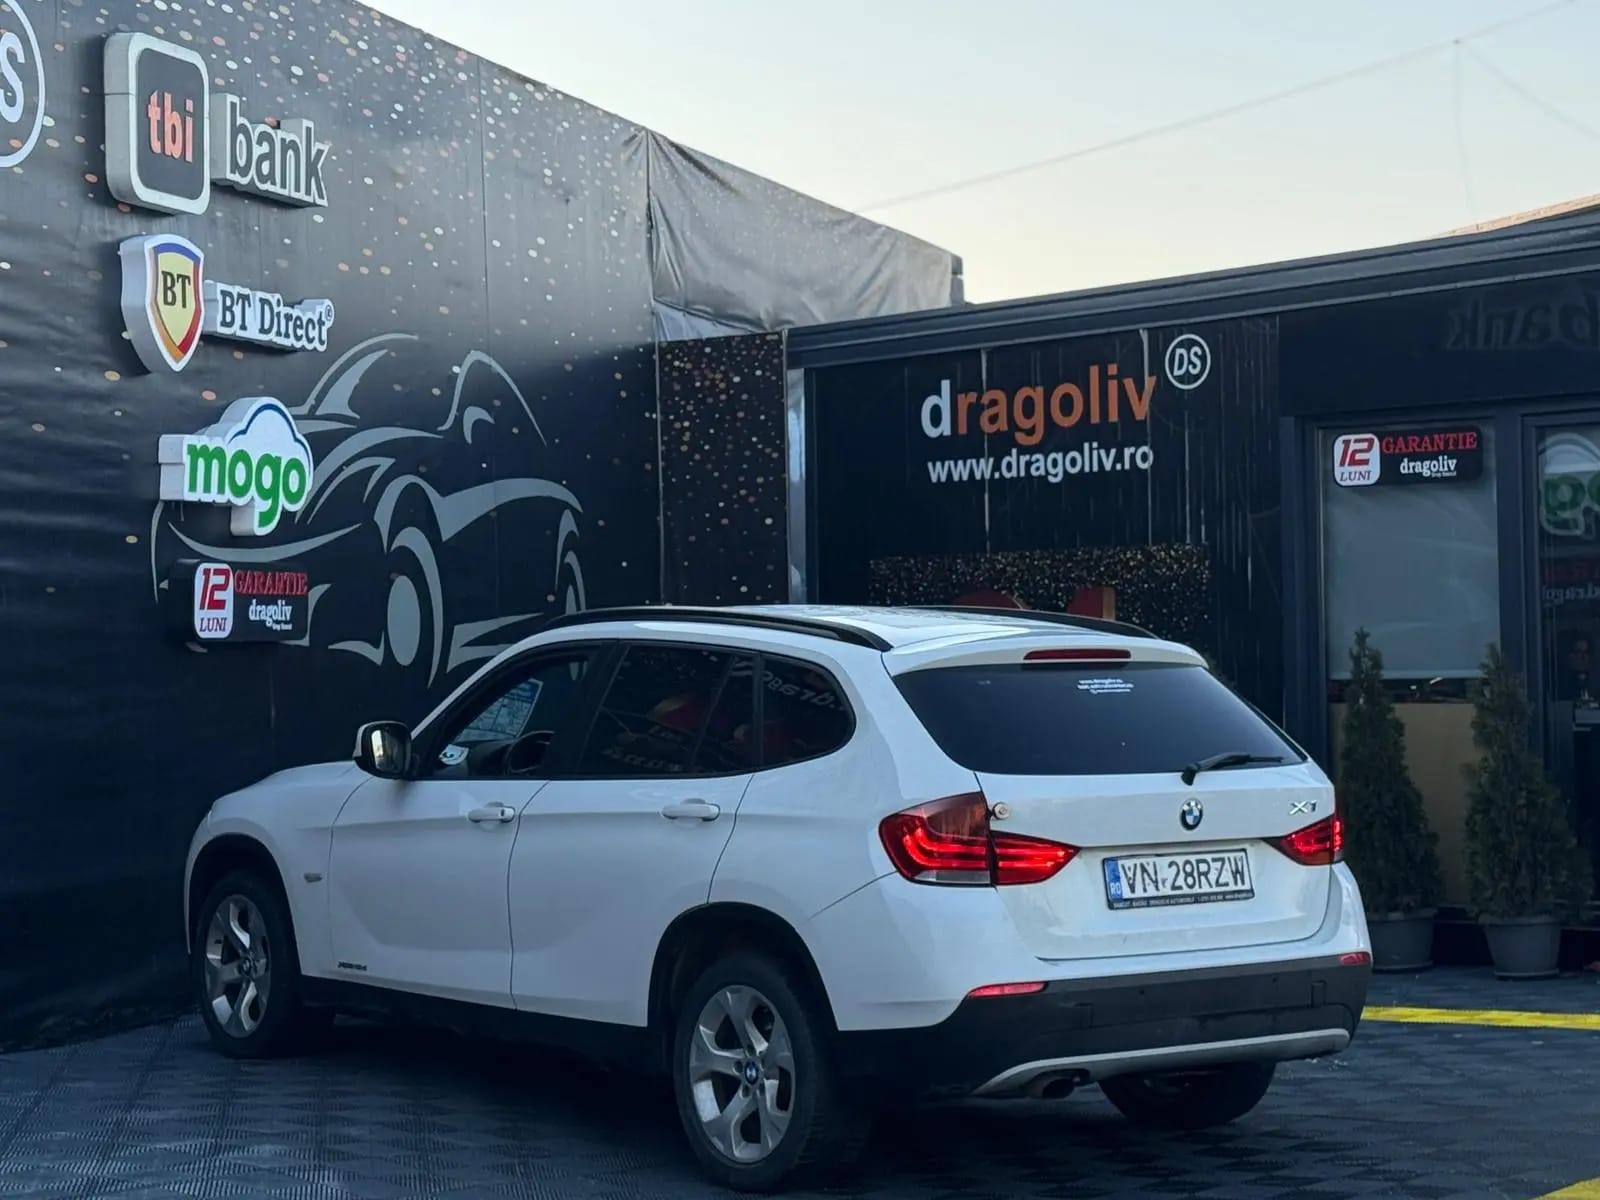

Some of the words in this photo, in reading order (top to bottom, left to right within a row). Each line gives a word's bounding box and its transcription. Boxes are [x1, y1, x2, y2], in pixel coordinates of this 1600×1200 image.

[147, 90, 194, 163] tbi
[227, 97, 329, 206] bank
[161, 270, 191, 309] BT
[219, 289, 250, 331] BT
[1172, 346, 1202, 377] DS
[920, 363, 1157, 446] dragoliv
[927, 441, 1154, 483] www.dragoliv.ro
[1339, 437, 1374, 467] 12
[1382, 431, 1478, 455] GARANTIE
[1399, 455, 1457, 477] dragoliv
[187, 443, 307, 528] mogo
[1339, 470, 1371, 482] LUNI
[199, 567, 230, 611] 12
[234, 569, 308, 596] GARANTIE
[199, 617, 228, 633] LUNI
[249, 599, 292, 626] dragoliv
[1289, 799, 1317, 815] X1
[1120, 861, 1160, 894] VN
[1168, 855, 1246, 892] 28RZW
